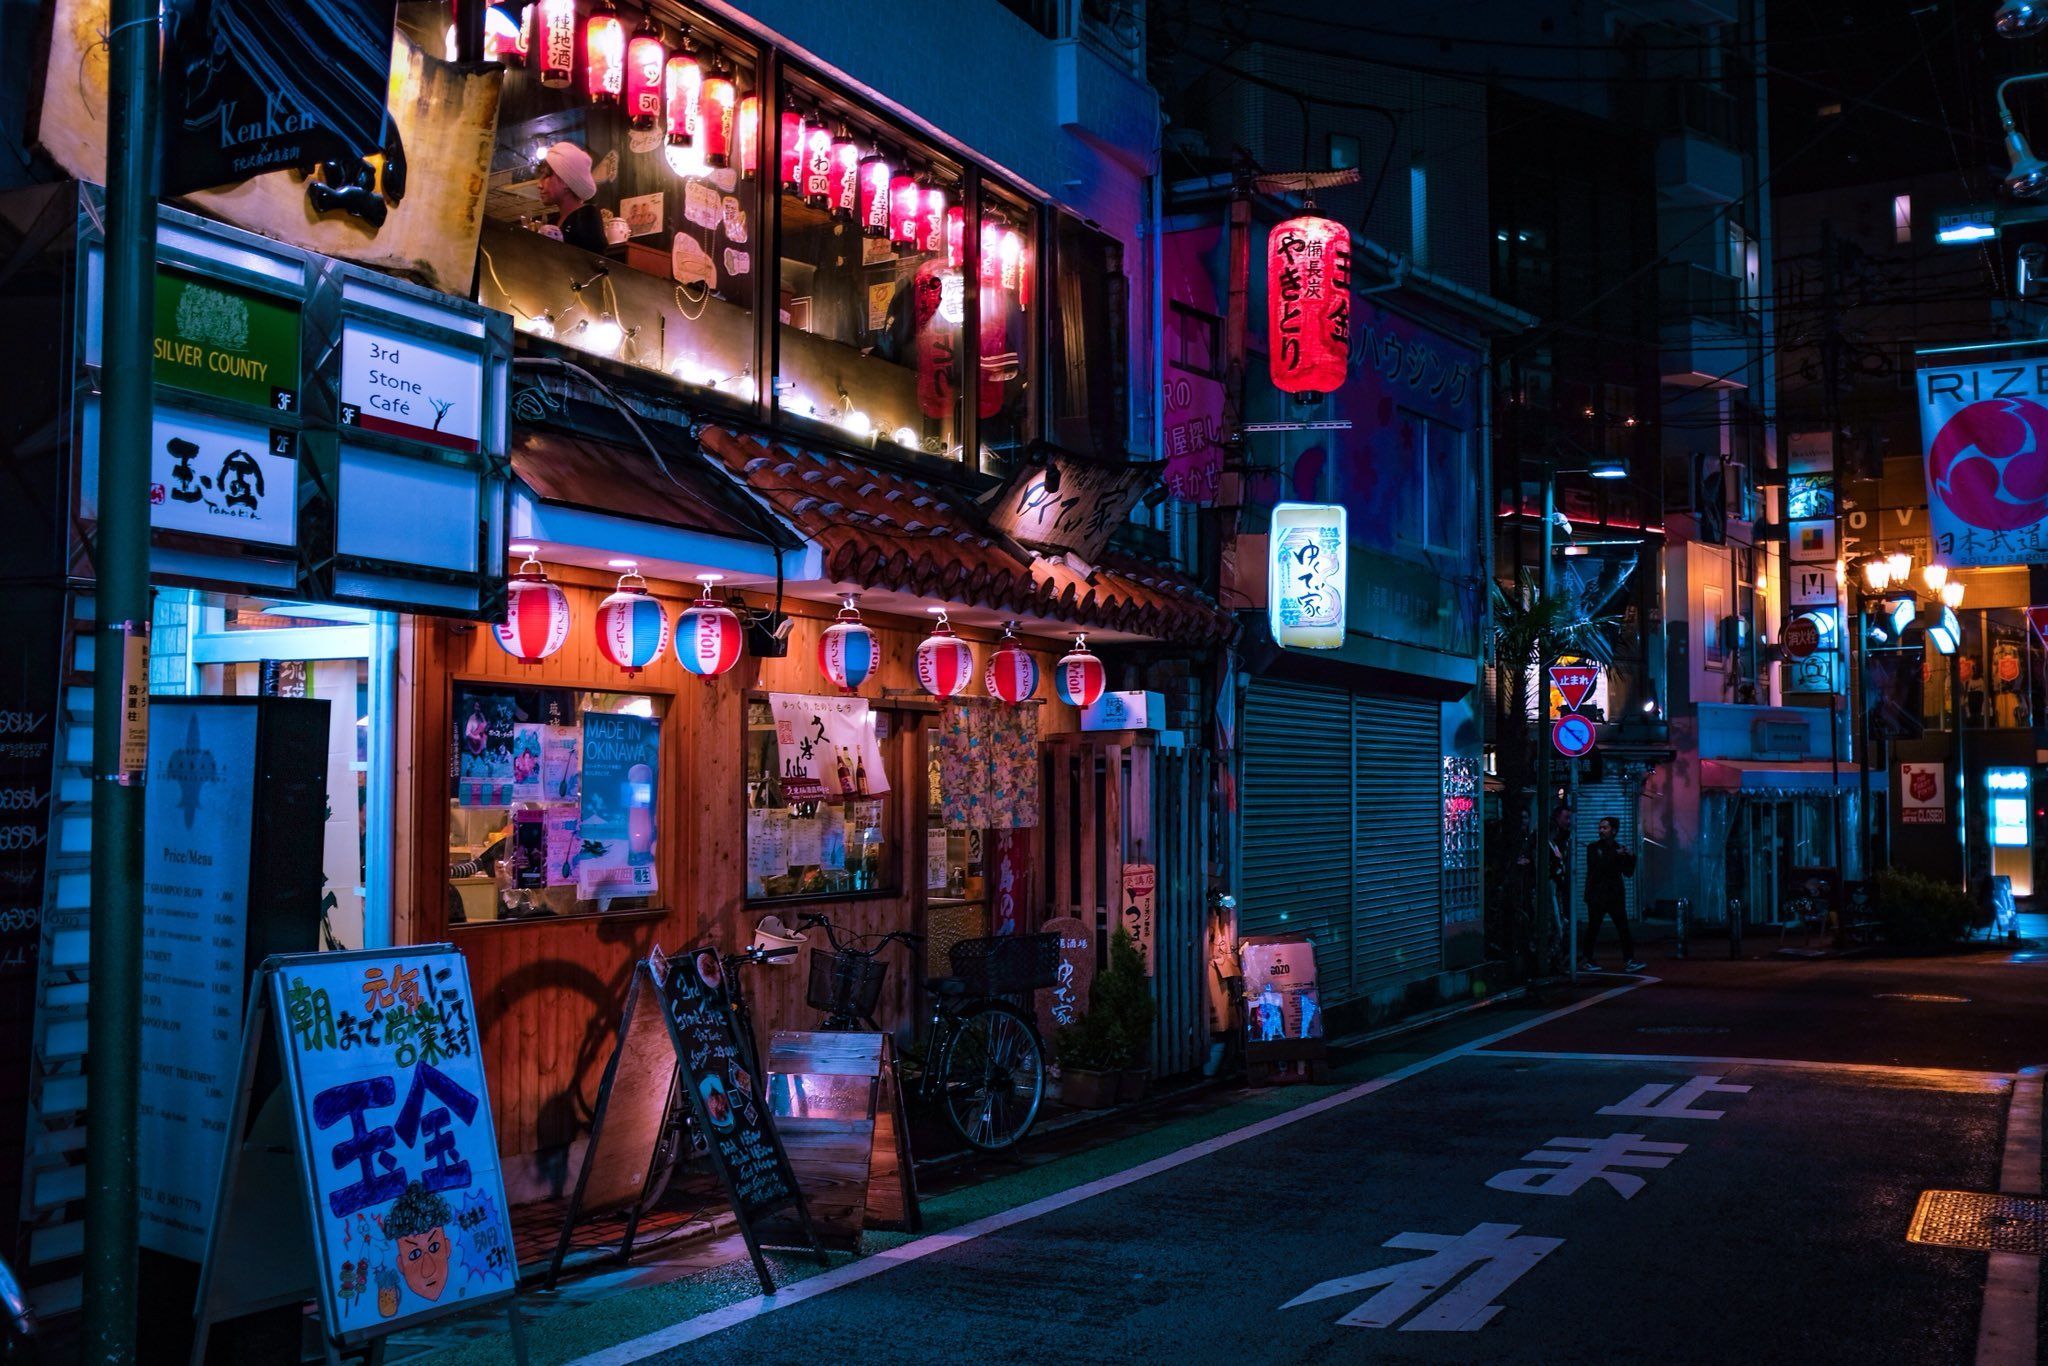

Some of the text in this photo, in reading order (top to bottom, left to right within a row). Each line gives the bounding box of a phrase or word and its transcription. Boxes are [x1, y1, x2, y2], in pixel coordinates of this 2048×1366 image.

[218, 92, 315, 149] KenKen
[811, 178, 829, 192] 50
[1305, 240, 1324, 299] 備長炭
[1277, 233, 1306, 371] やきとり
[154, 337, 267, 384] SILVER COUNTY
[370, 343, 400, 365] 3rd
[369, 369, 422, 396] Stone
[276, 391, 291, 411] 3F
[369, 394, 411, 417] Café
[341, 406, 356, 424] 3F
[276, 434, 290, 453] 2F
[701, 613, 720, 659] Orion
[1788, 628, 1817, 646] 消火栓
[1069, 662, 1084, 695] Orion
[1559, 674, 1590, 687] 止まれ
[586, 720, 642, 740] MADE IN
[586, 741, 650, 763] OKINAWA
[163, 848, 213, 866] Price/Menu
[1271, 965, 1290, 975] GOZO
[313, 1061, 479, 1219] 玉金
[1278, 1075, 1753, 1333] 止まれ
